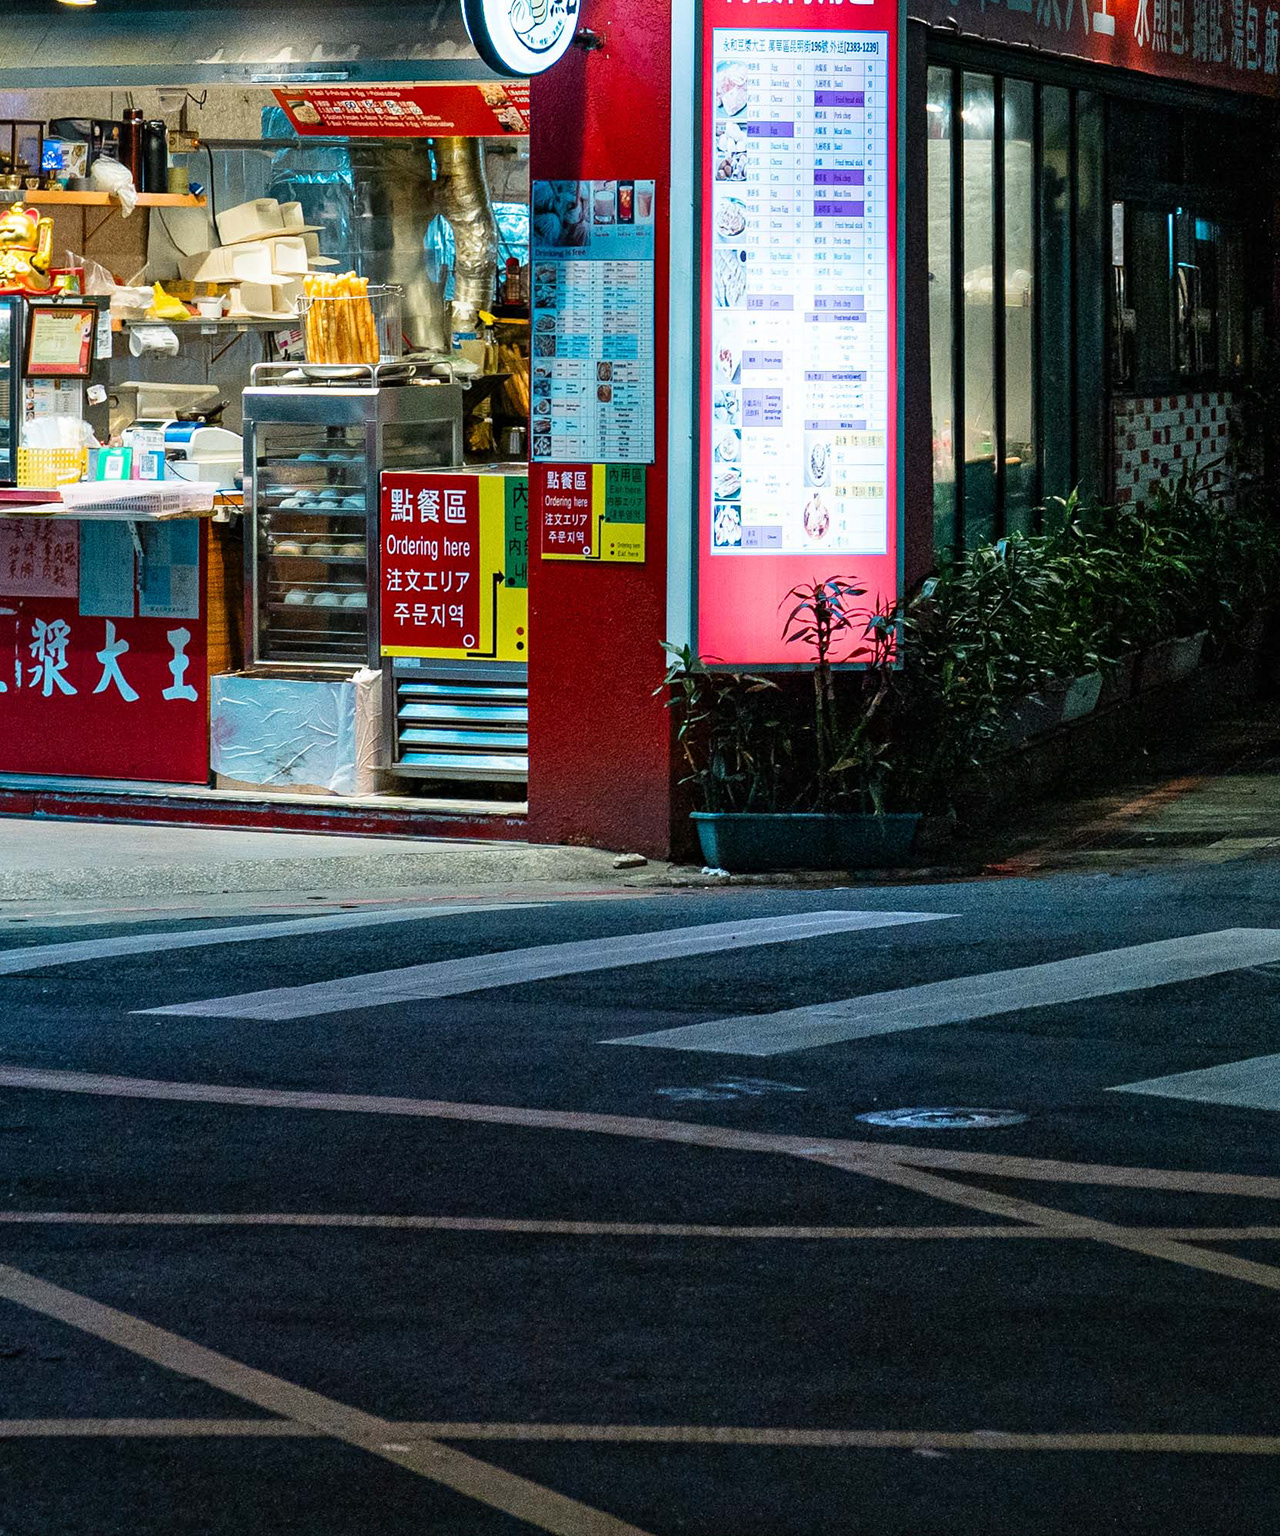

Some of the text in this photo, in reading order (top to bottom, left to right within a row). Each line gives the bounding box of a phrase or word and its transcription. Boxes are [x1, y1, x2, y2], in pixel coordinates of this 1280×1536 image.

[547, 471, 587, 490] 點餐區
[609, 468, 642, 483] 內用區
[390, 489, 468, 524] 點餐區
[545, 495, 588, 509] Ordering here
[545, 513, 588, 526] 注文エリア
[548, 531, 585, 544] 주문지역
[387, 535, 470, 561] Ordering here
[387, 568, 470, 593] 注文エリア
[394, 602, 465, 627] 주문지역
